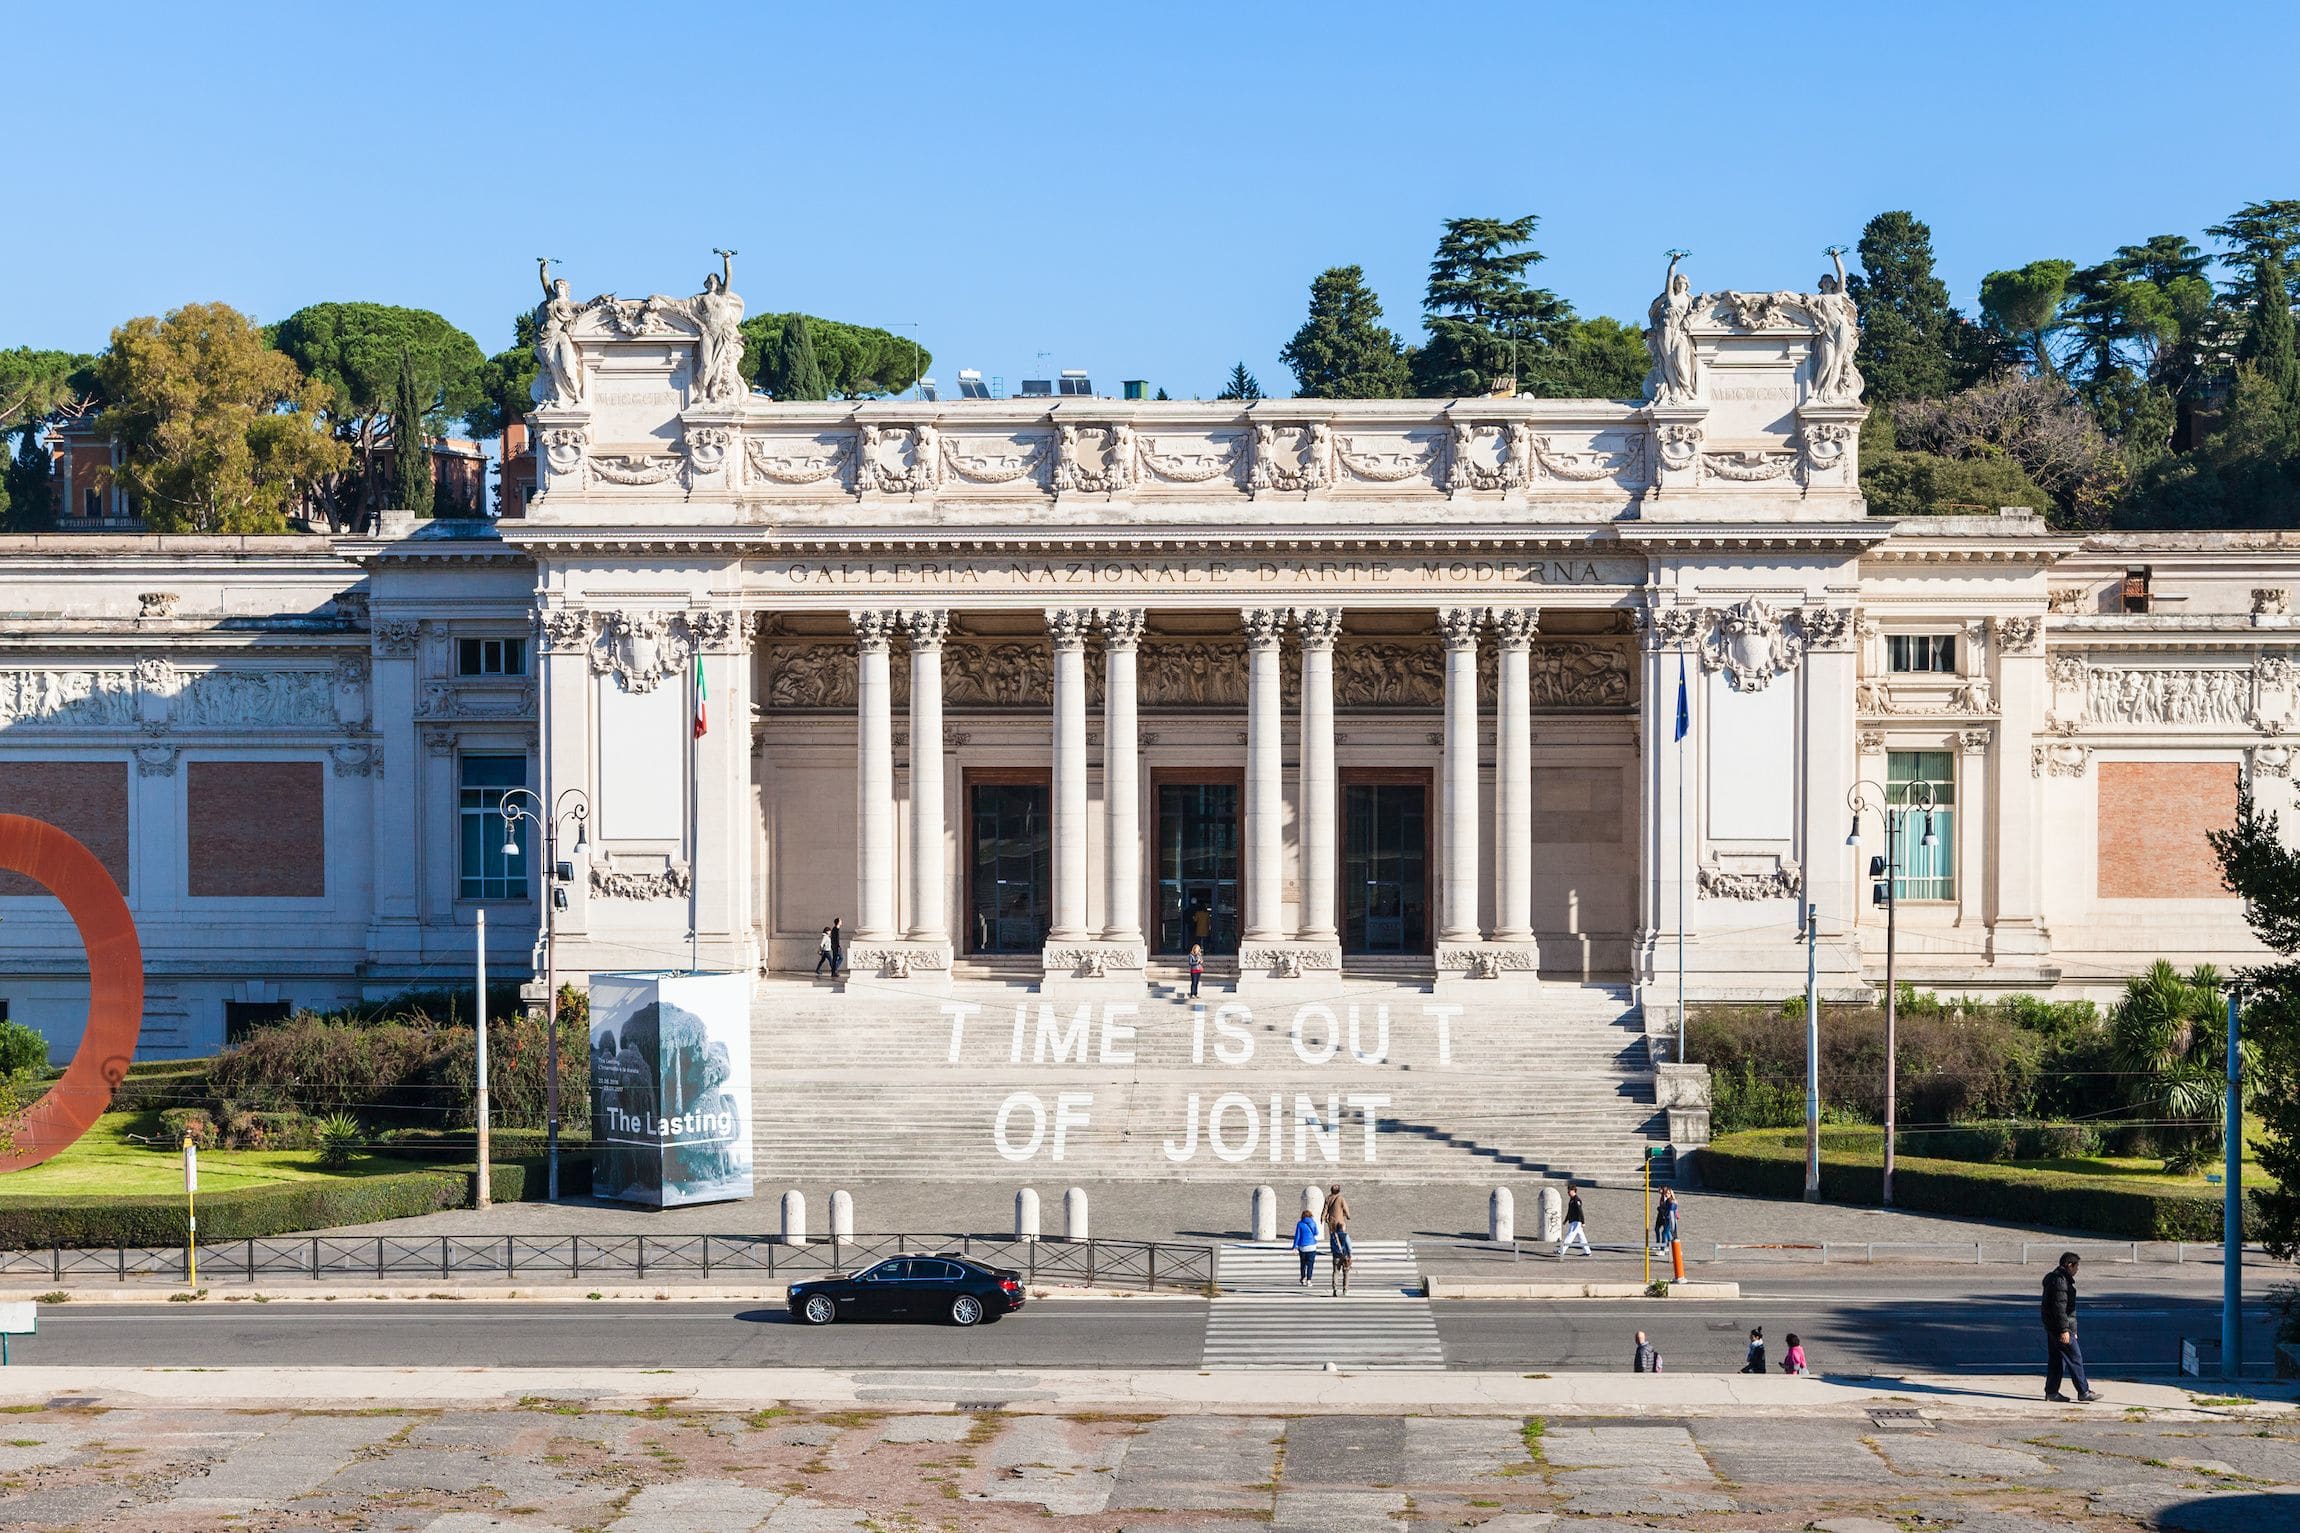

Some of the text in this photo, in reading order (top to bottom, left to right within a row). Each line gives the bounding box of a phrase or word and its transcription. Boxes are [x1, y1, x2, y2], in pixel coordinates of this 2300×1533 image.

[788, 561, 1600, 585] GALLERIA NAZIONALE D'ARTE MODERNA
[1191, 1003, 1255, 1064] IS
[606, 1106, 733, 1137] The Lasting
[993, 1091, 1392, 1162] OF JOINT
